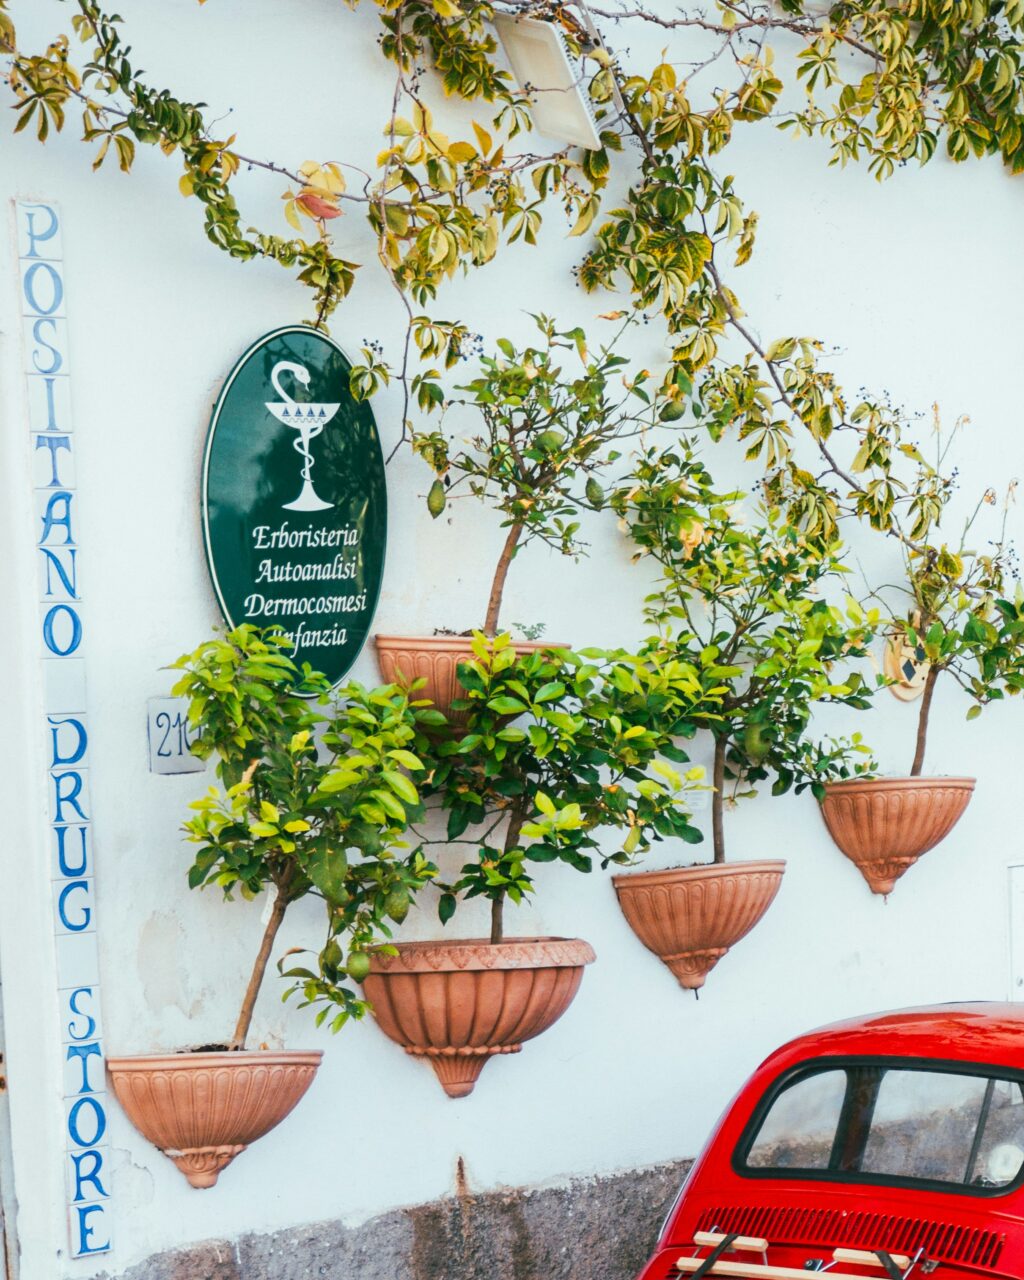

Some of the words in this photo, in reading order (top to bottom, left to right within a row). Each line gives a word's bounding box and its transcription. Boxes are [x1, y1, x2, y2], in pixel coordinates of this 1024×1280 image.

[18, 204, 83, 656] POSITANO
[252, 521, 359, 549] Erboristeria
[254, 554, 357, 583] Autoanalisi
[243, 588, 367, 617] Dermocosmesi
[47, 716, 92, 932] DRUG
[67, 987, 112, 1255] STORE
